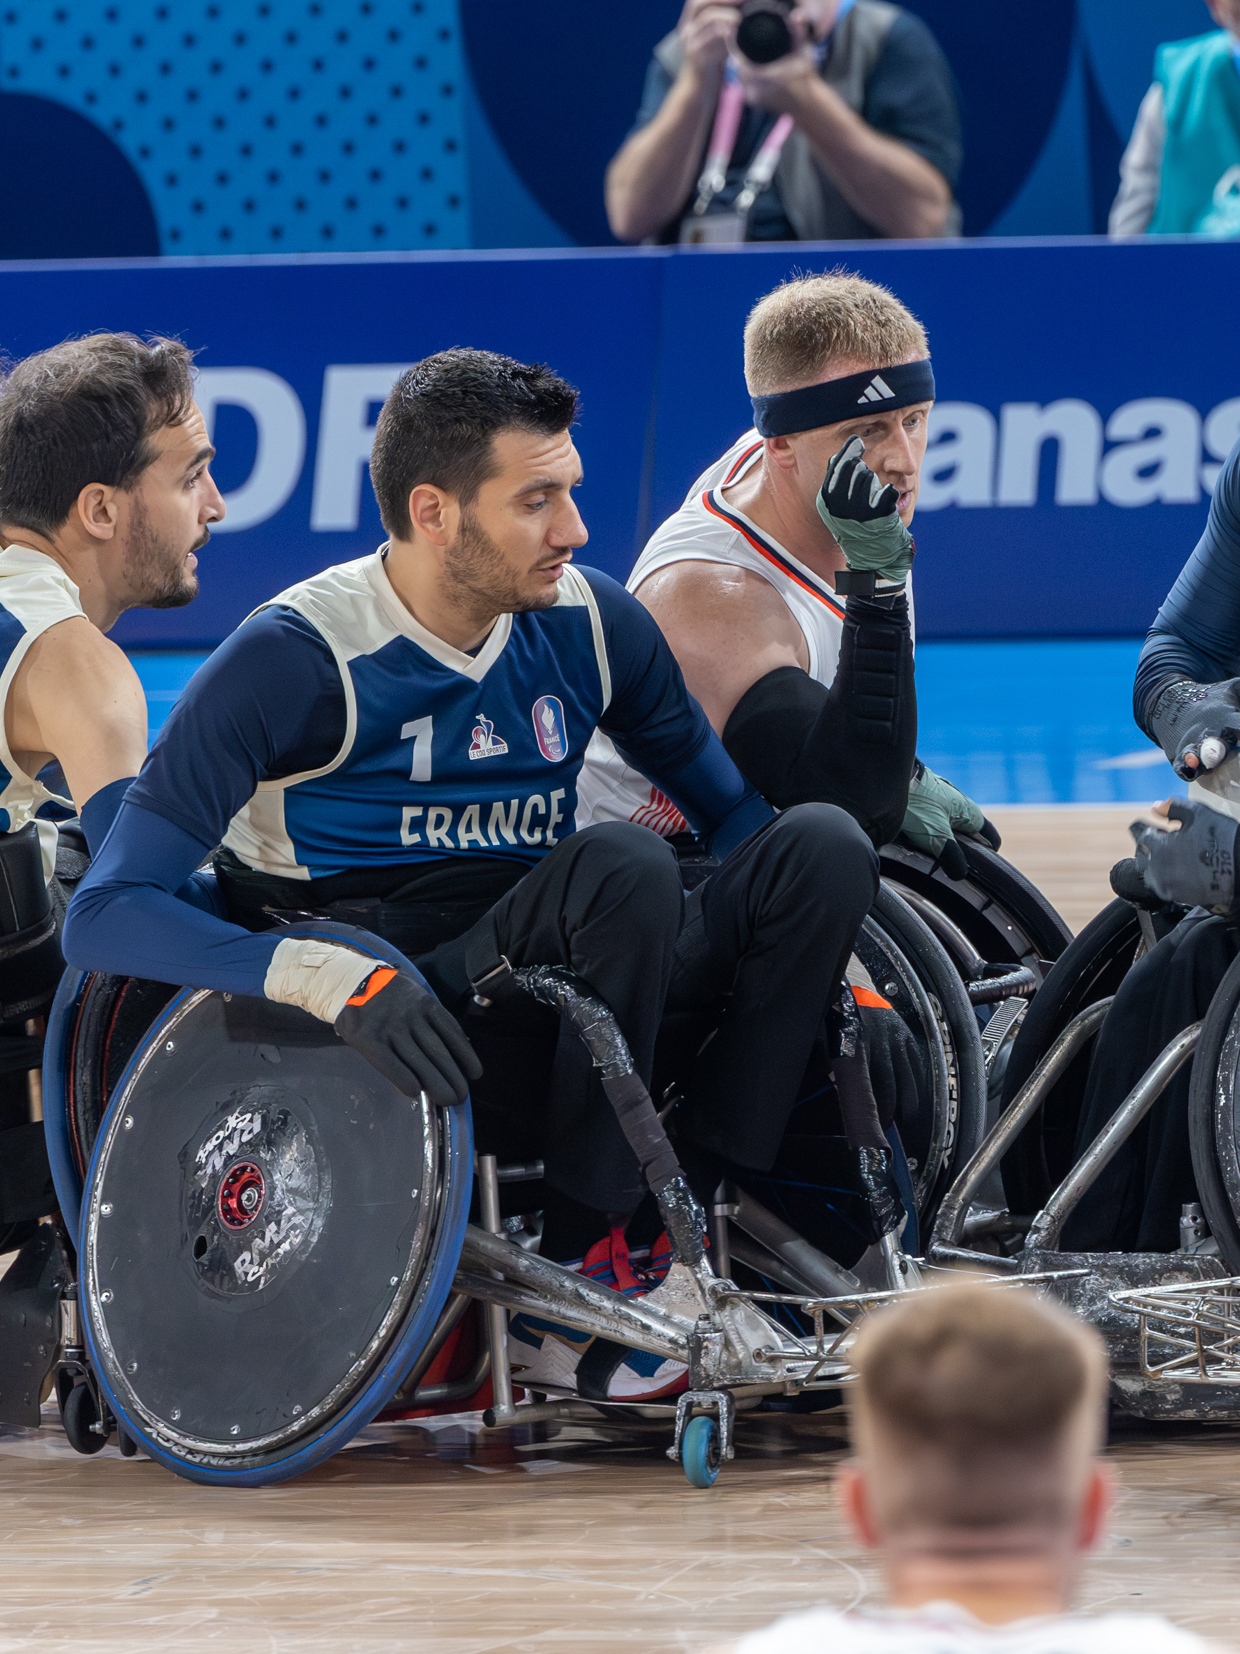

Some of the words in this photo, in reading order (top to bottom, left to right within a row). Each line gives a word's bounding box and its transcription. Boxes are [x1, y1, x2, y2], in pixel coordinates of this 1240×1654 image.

[192, 362, 418, 534] DF
[400, 715, 434, 782] 1
[400, 788, 566, 850] FRANCE
[143, 1426, 252, 1467] PINERGY
